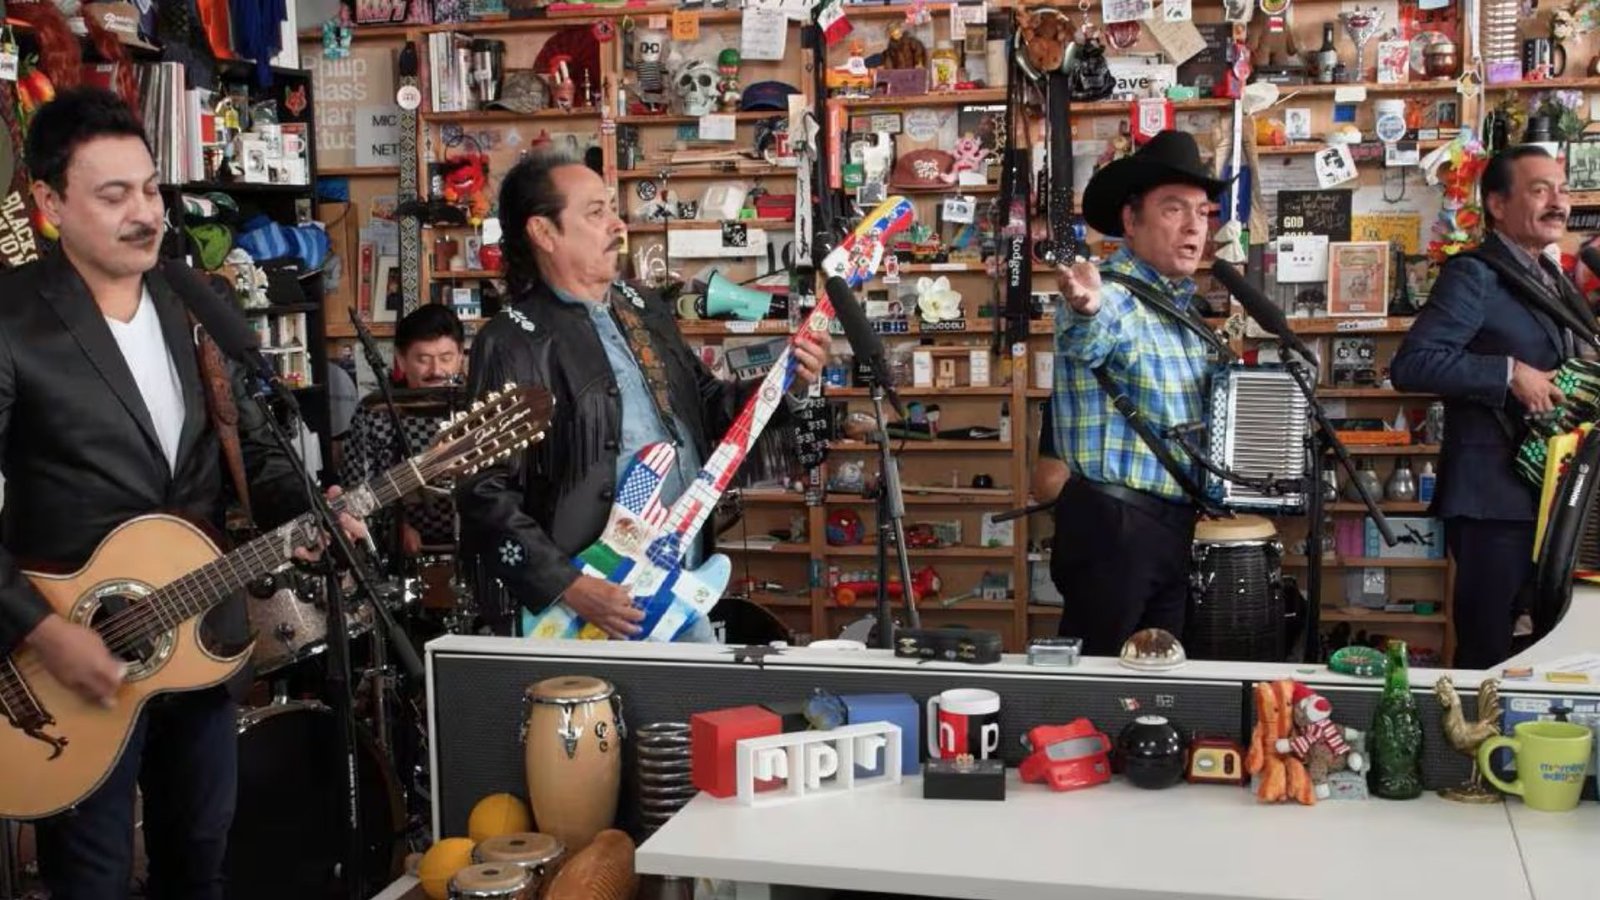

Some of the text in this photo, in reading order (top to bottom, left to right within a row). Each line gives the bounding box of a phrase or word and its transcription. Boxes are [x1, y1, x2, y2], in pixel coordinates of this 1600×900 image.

[1115, 76, 1149, 89] ave
[1283, 216, 1304, 229] GOD
[1008, 234, 1024, 287] Rodgers
[754, 735, 888, 790] npr
